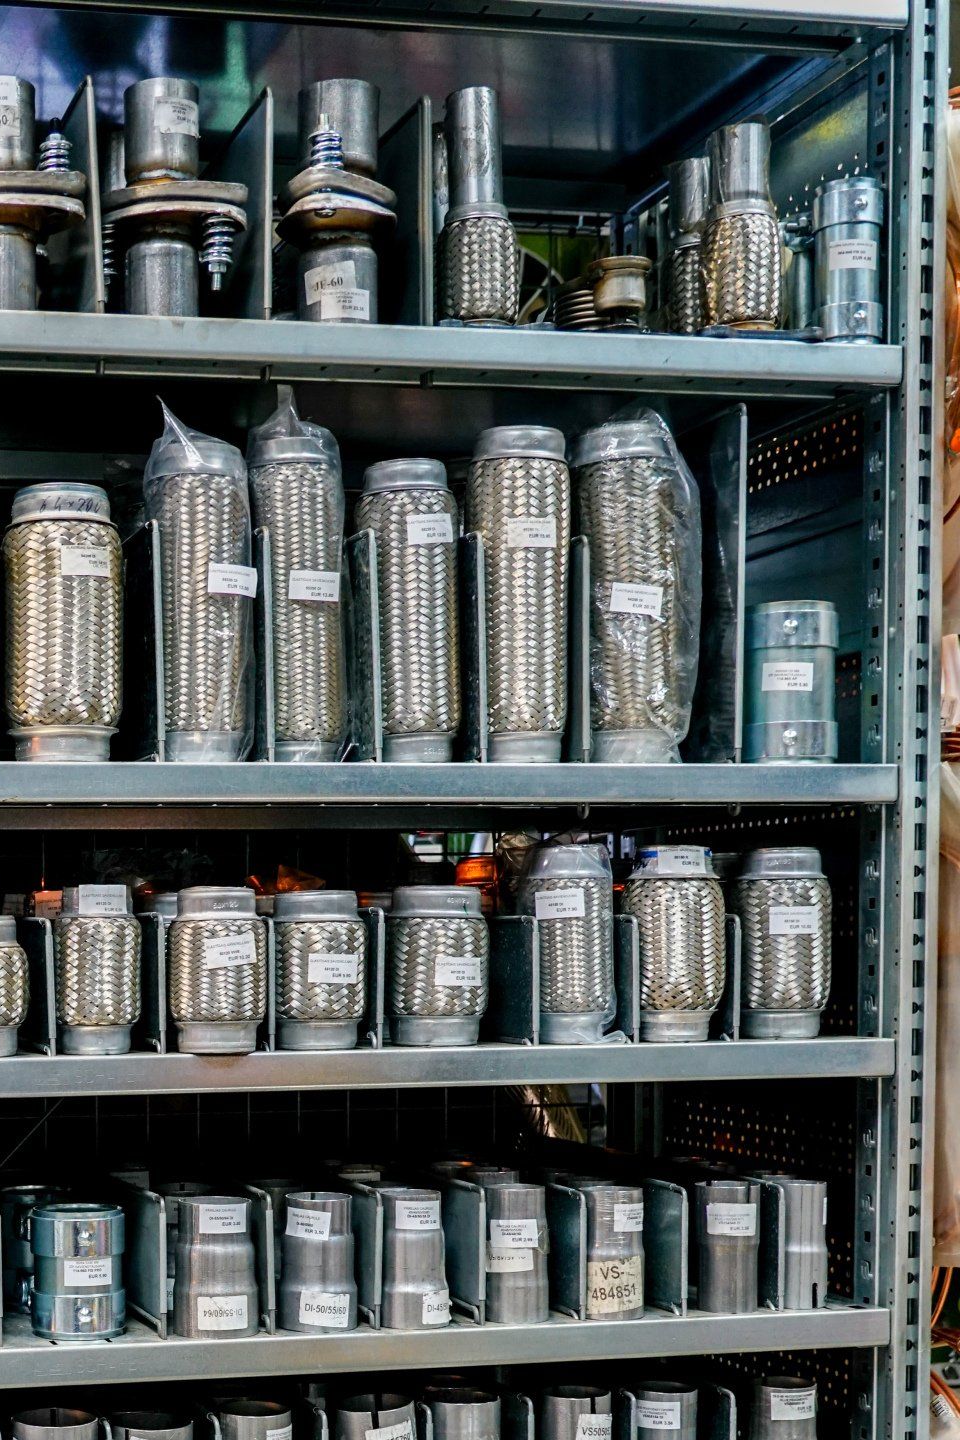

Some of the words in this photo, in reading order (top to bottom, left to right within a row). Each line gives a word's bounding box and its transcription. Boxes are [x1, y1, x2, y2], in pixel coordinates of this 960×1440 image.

[314, 277, 343, 291] JF-60
[600, 1266, 624, 1280] VS-
[592, 1288, 637, 1301] 484851
[305, 1304, 347, 1315] DI-50/55/60
